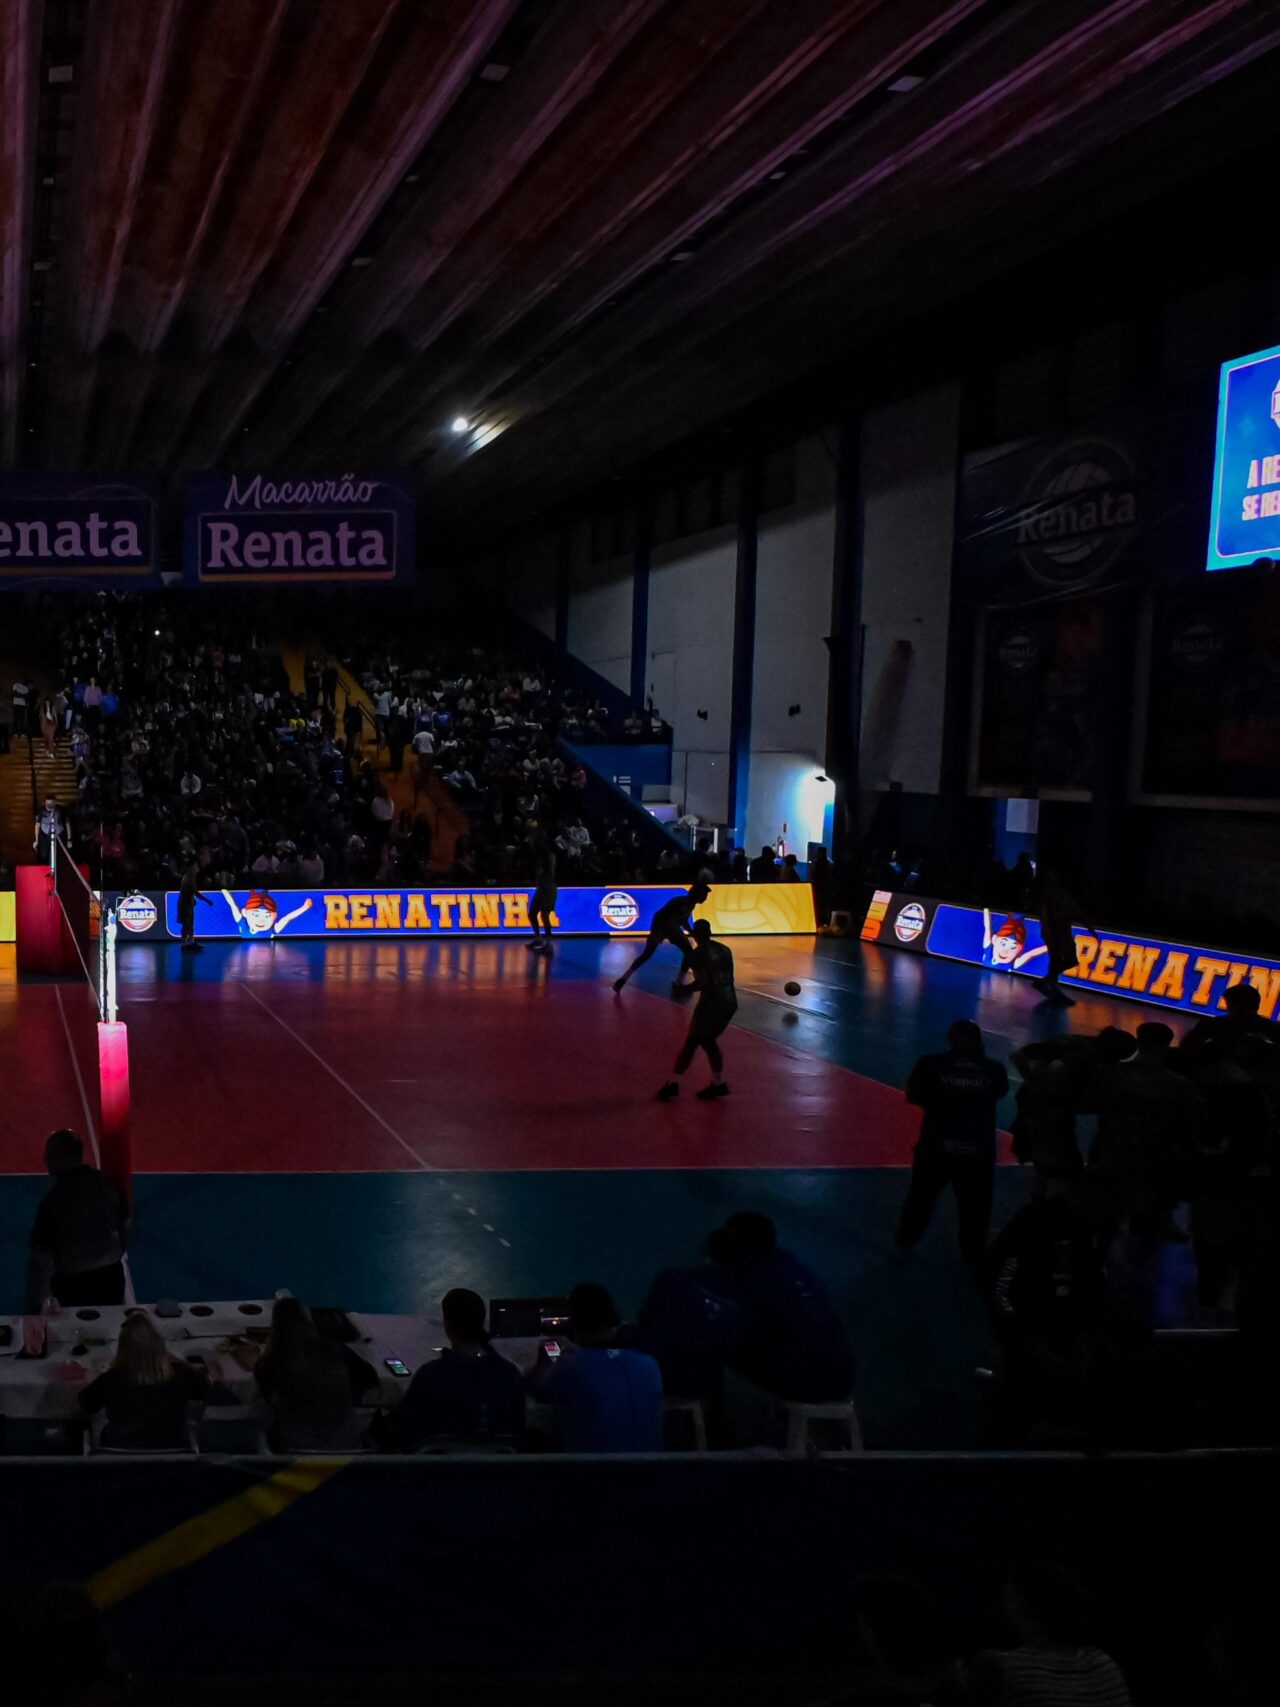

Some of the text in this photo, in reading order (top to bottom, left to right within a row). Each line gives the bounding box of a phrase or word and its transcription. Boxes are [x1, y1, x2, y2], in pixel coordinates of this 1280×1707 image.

[223, 473, 381, 511] Macarrão
[206, 521, 388, 568] Renata
[323, 893, 560, 929] RENATINH
